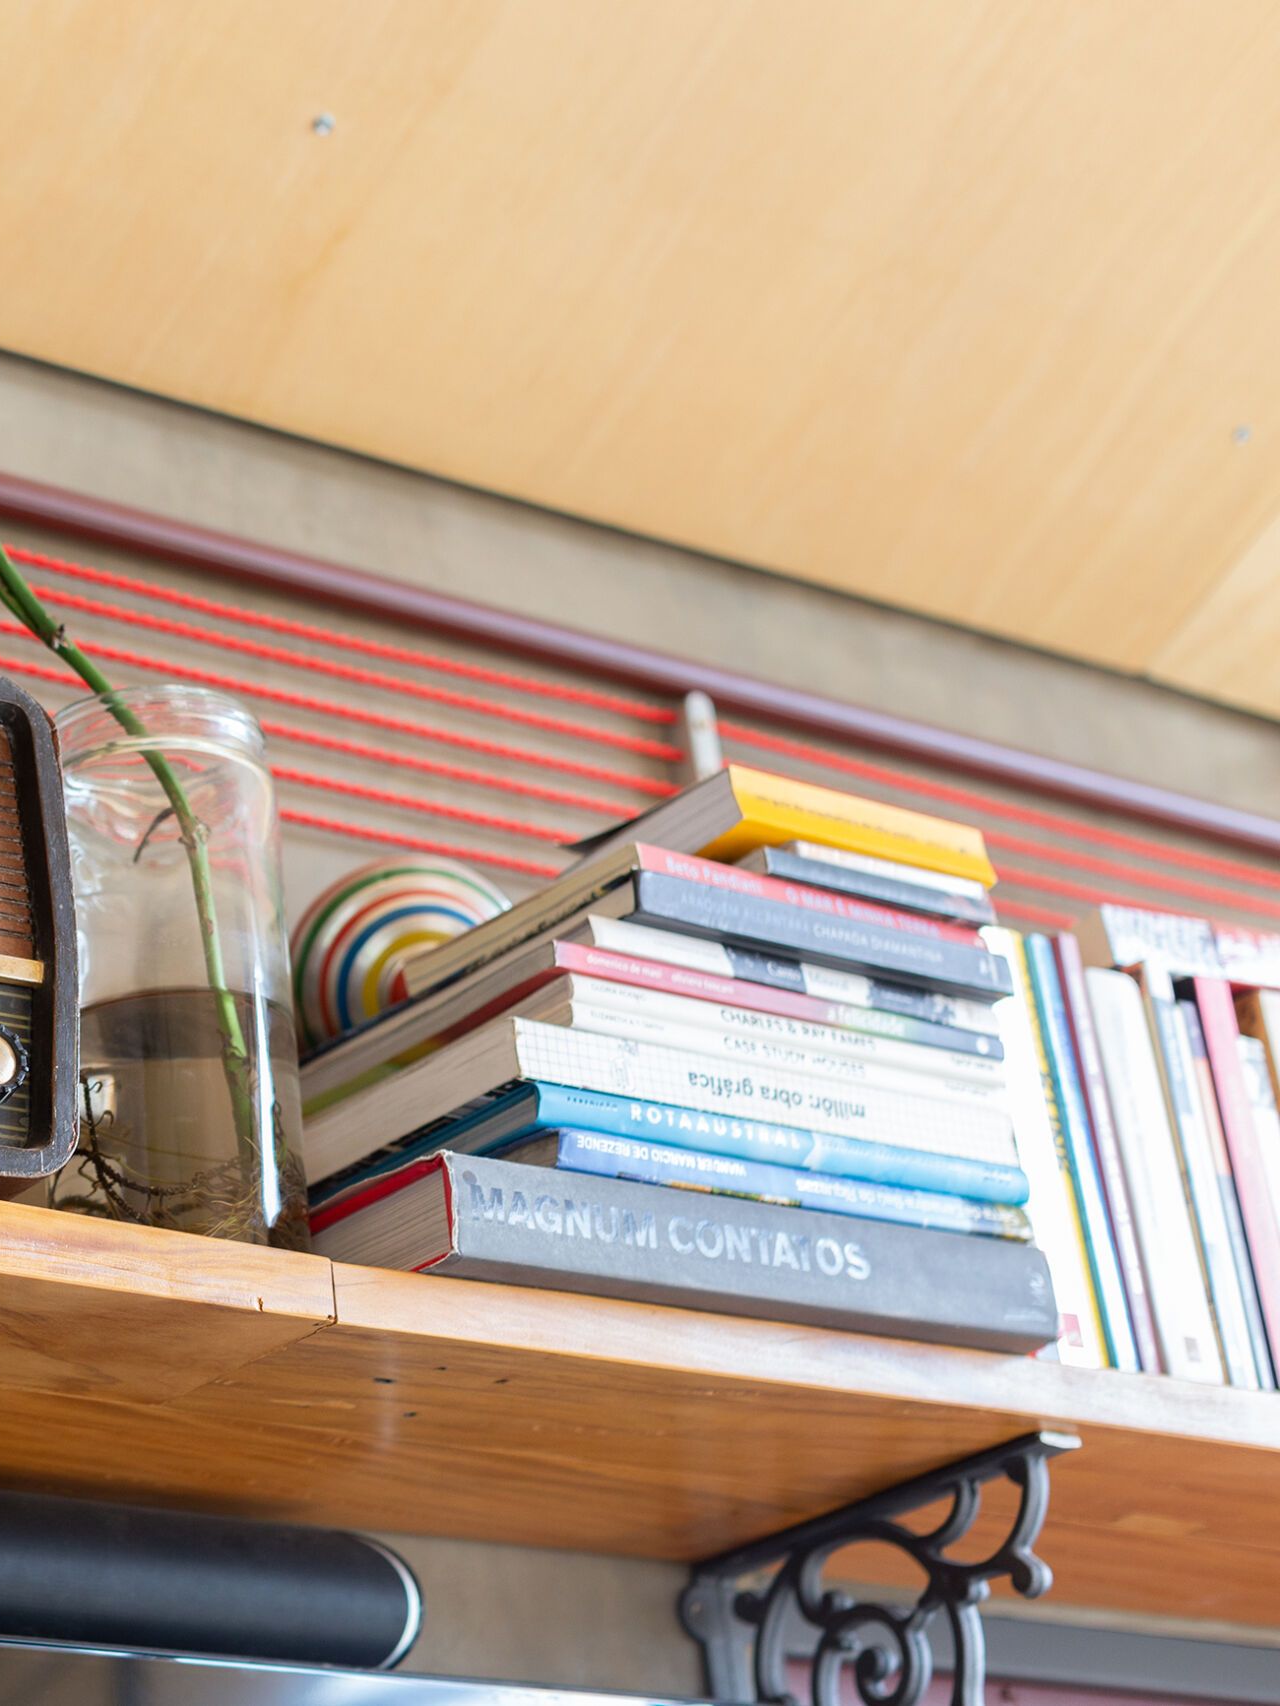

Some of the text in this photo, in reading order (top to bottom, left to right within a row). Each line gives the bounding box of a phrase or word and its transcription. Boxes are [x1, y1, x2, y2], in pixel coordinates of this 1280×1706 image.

[687, 1071, 753, 1100] gráfica
[760, 1085, 803, 1110] obra
[576, 1136, 630, 1158] REZENDE
[633, 1146, 649, 1161] DE
[470, 1182, 871, 1280] MAGNUM CONTATOS
